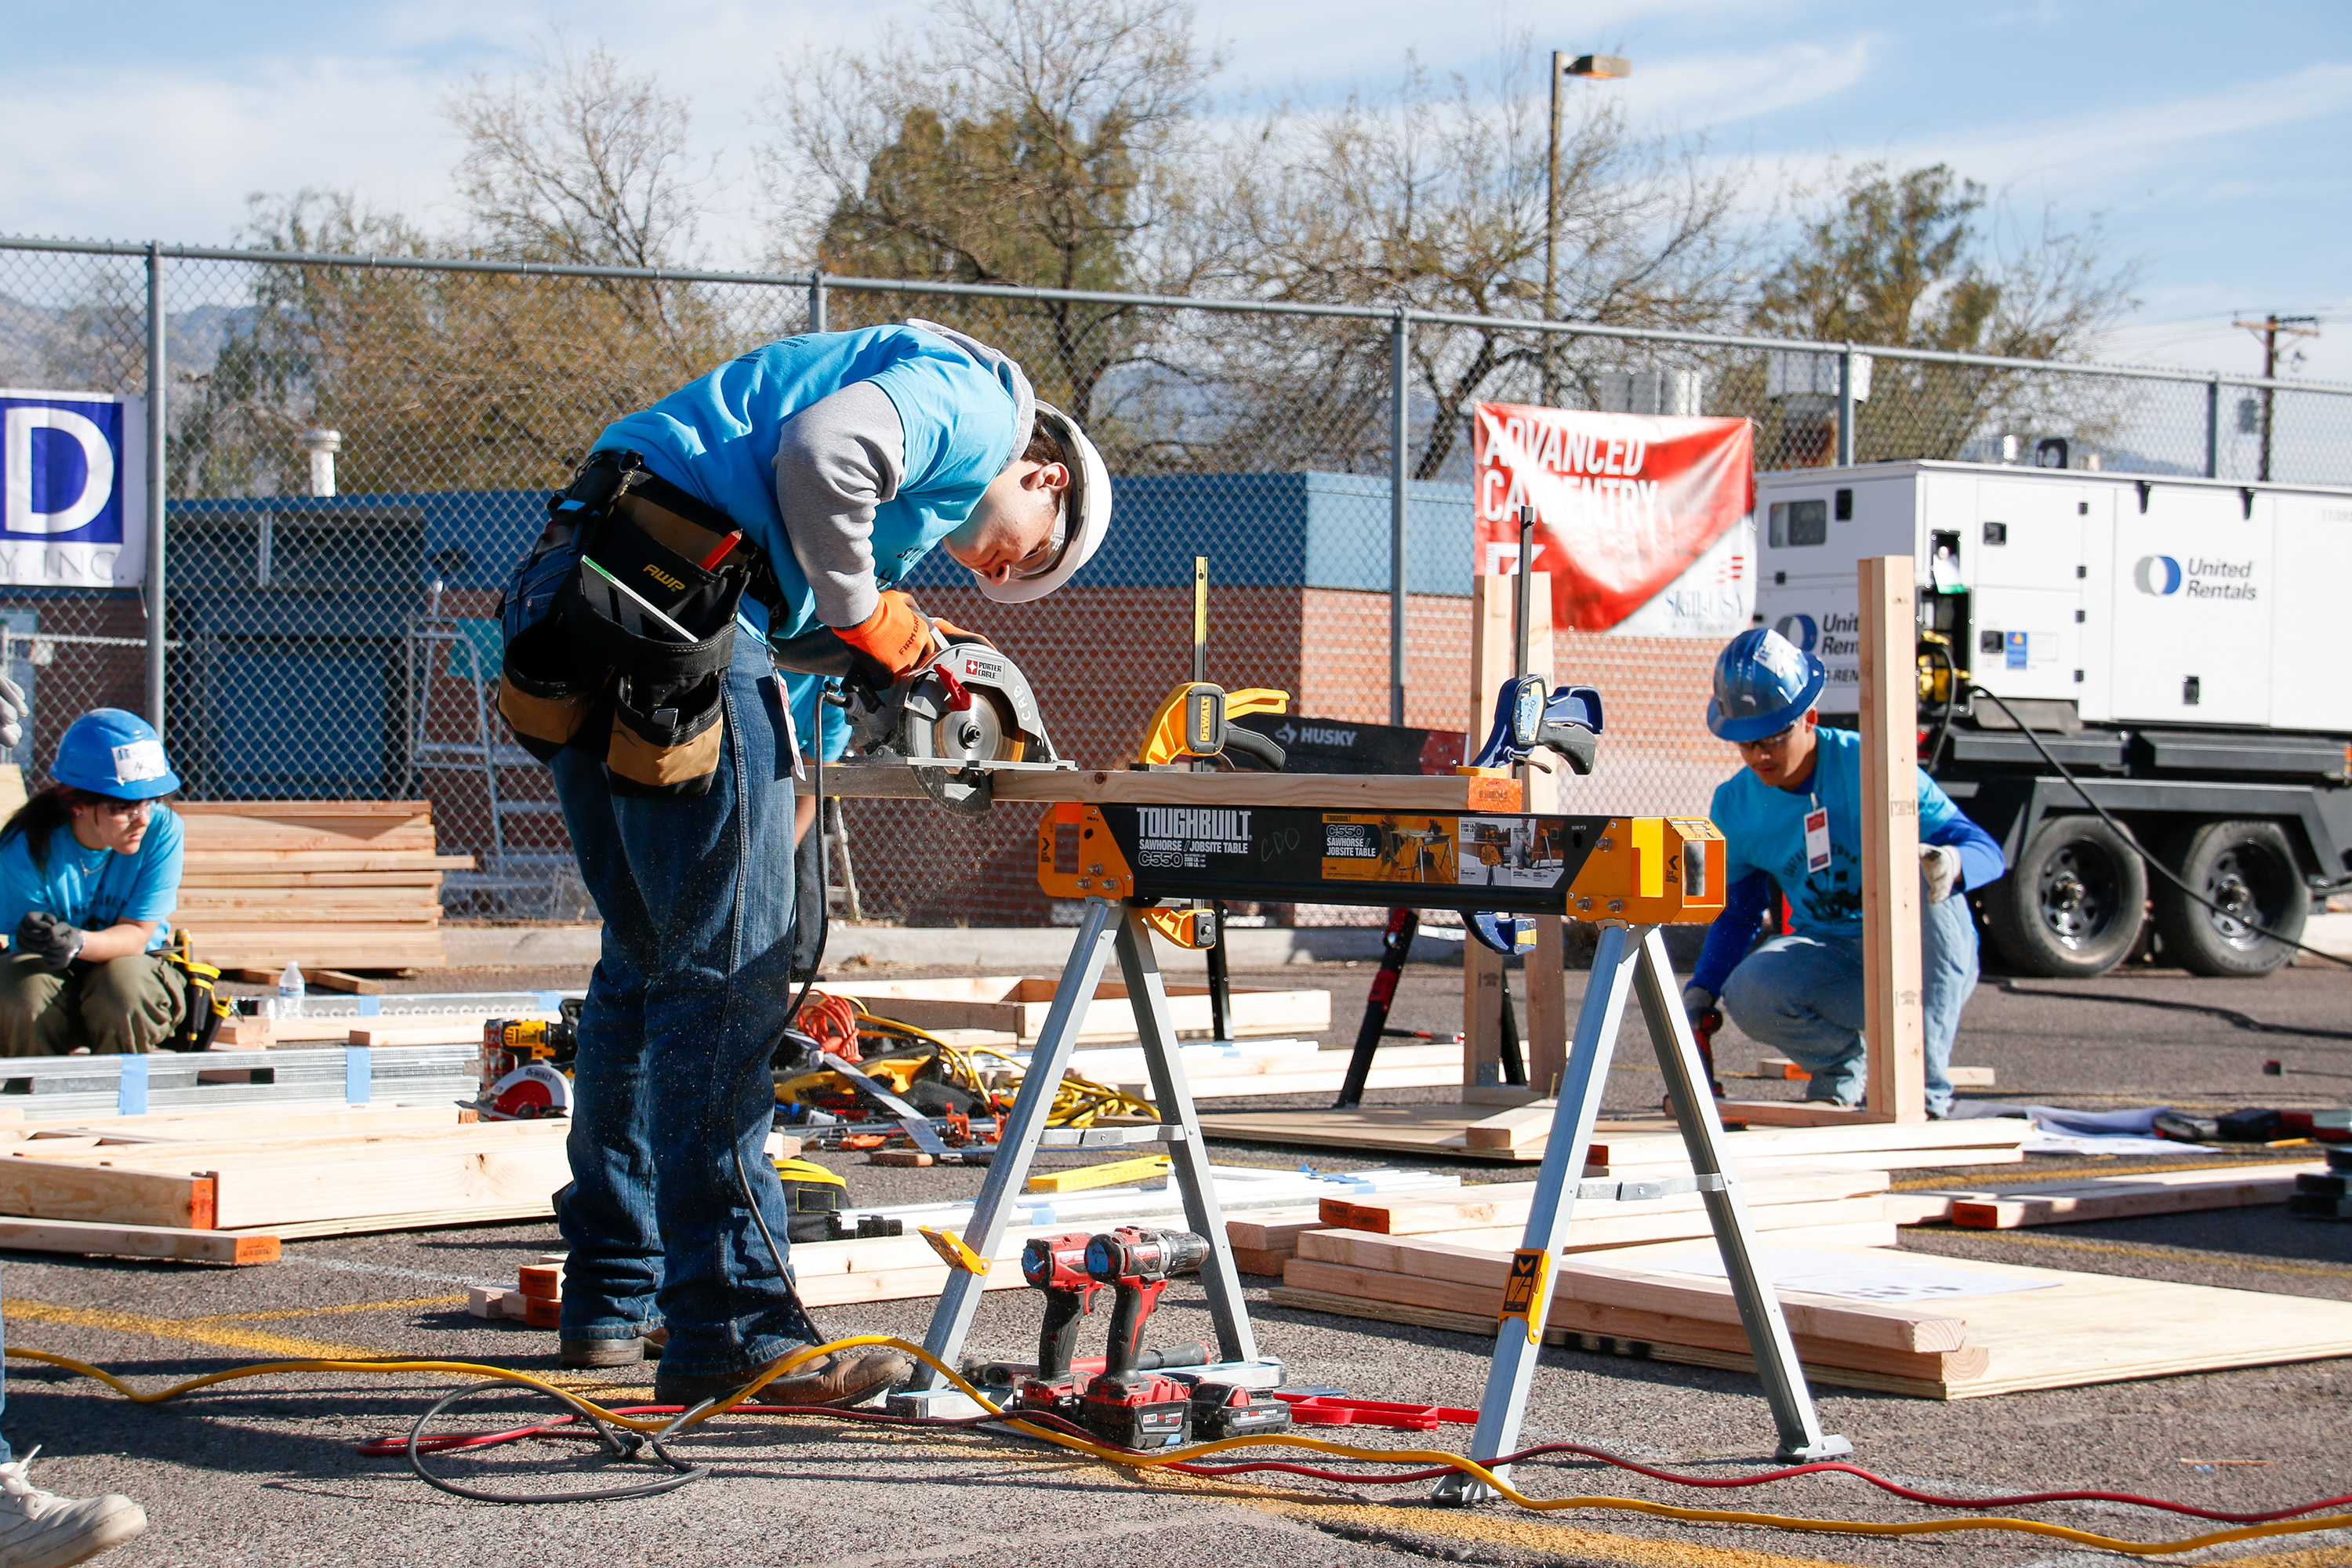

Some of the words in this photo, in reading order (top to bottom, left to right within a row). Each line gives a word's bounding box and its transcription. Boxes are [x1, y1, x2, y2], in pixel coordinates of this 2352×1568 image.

[1482, 416, 1647, 477] ADVANCED
[5, 405, 115, 535] D
[43, 550, 125, 581] INC.
[2187, 557, 2252, 579] United
[643, 564, 686, 590] AWP
[2186, 579, 2257, 601] Rentals
[898, 633, 916, 655] FIRM
[978, 662, 1002, 672] PORTER
[978, 670, 996, 680] CABLE
[1301, 727, 1357, 746] HUSKY
[1137, 808, 1252, 841] TOUGHBUILT
[1327, 825, 1364, 837] C550
[1139, 839, 1182, 851] SAWHORSE
[1223, 842, 1248, 853] TABLE
[1327, 837, 1363, 848] SAWHORSE
[1327, 847, 1353, 856] JOBSITE
[1355, 848, 1376, 857] TABLE
[1138, 851, 1183, 868] C550
